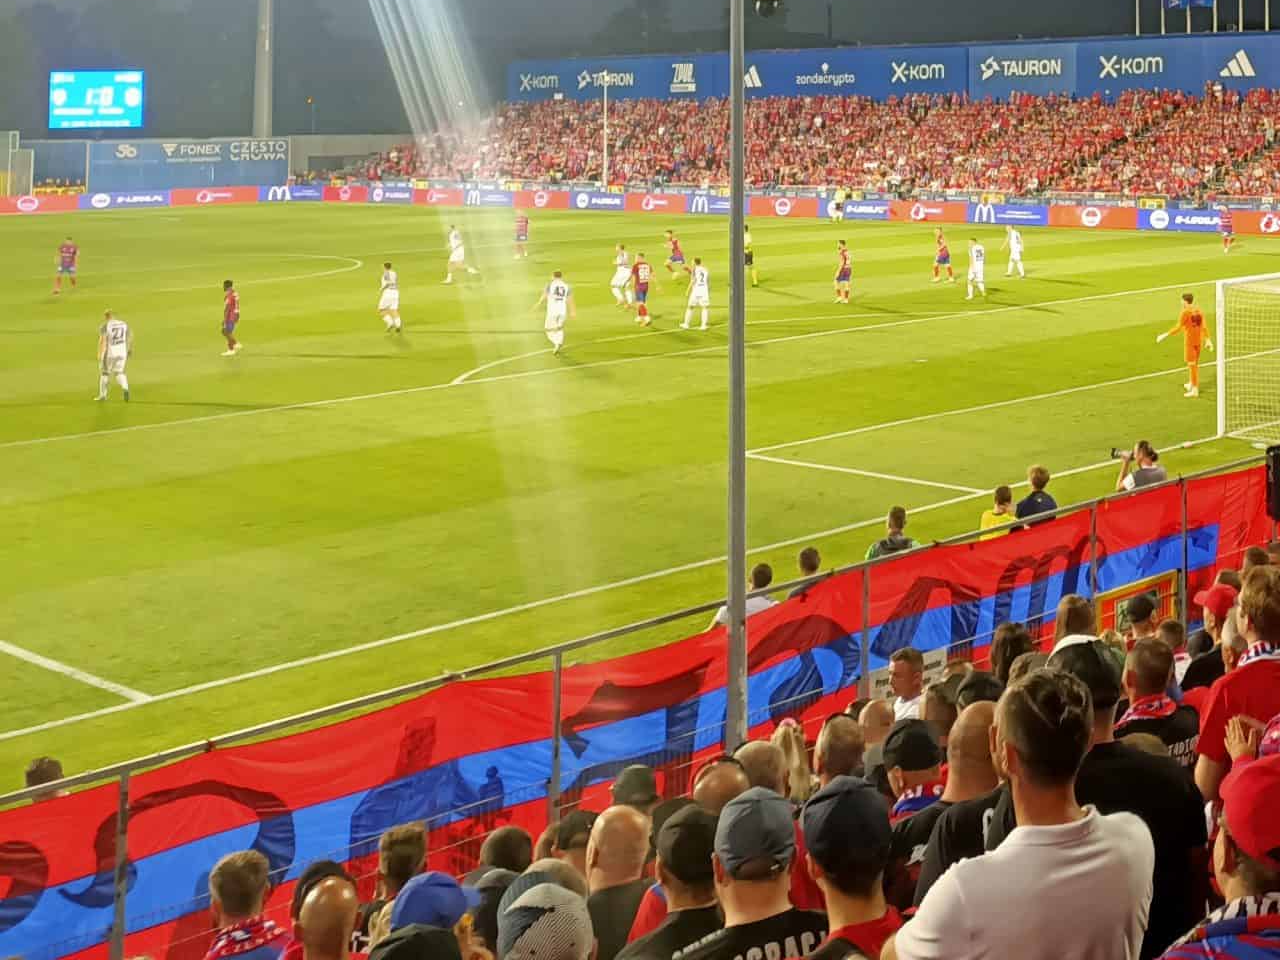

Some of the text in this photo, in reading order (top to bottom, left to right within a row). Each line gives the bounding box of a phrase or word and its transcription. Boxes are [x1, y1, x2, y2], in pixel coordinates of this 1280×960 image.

[1003, 59, 1061, 76] TAURON
[592, 72, 634, 89] TAURON
[797, 73, 855, 87] zondacrypto
[181, 144, 222, 155] FONEX
